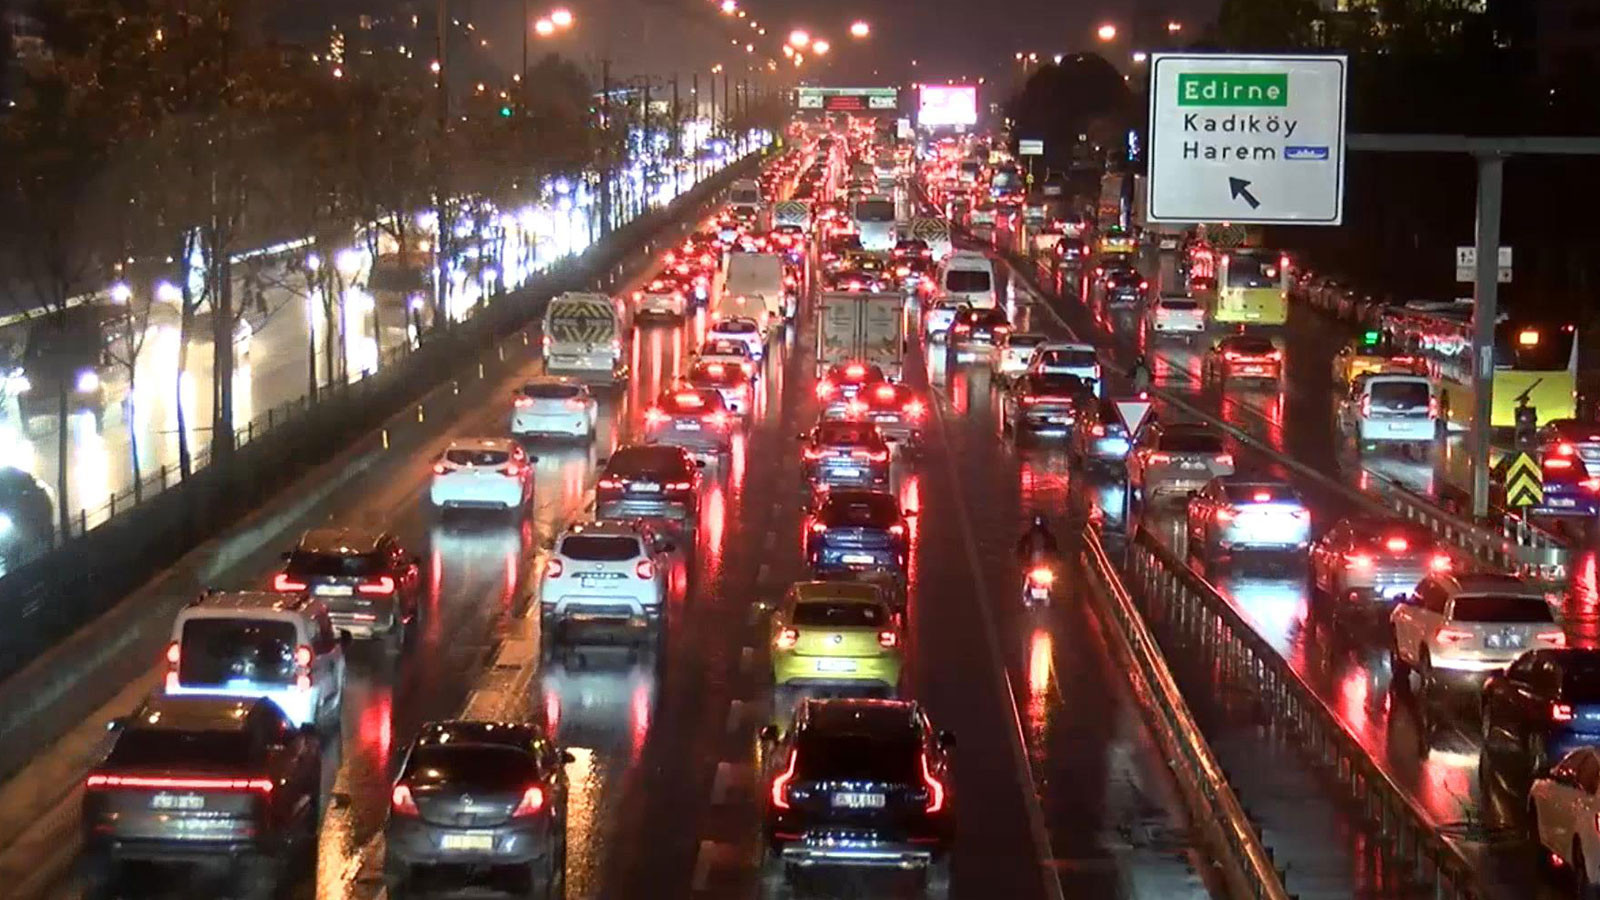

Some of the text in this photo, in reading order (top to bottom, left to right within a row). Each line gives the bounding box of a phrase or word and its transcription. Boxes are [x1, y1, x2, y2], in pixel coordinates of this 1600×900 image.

[1185, 80, 1281, 99] Edirne
[1184, 113, 1298, 138] Kadıköy
[1183, 141, 1276, 160] Harem
